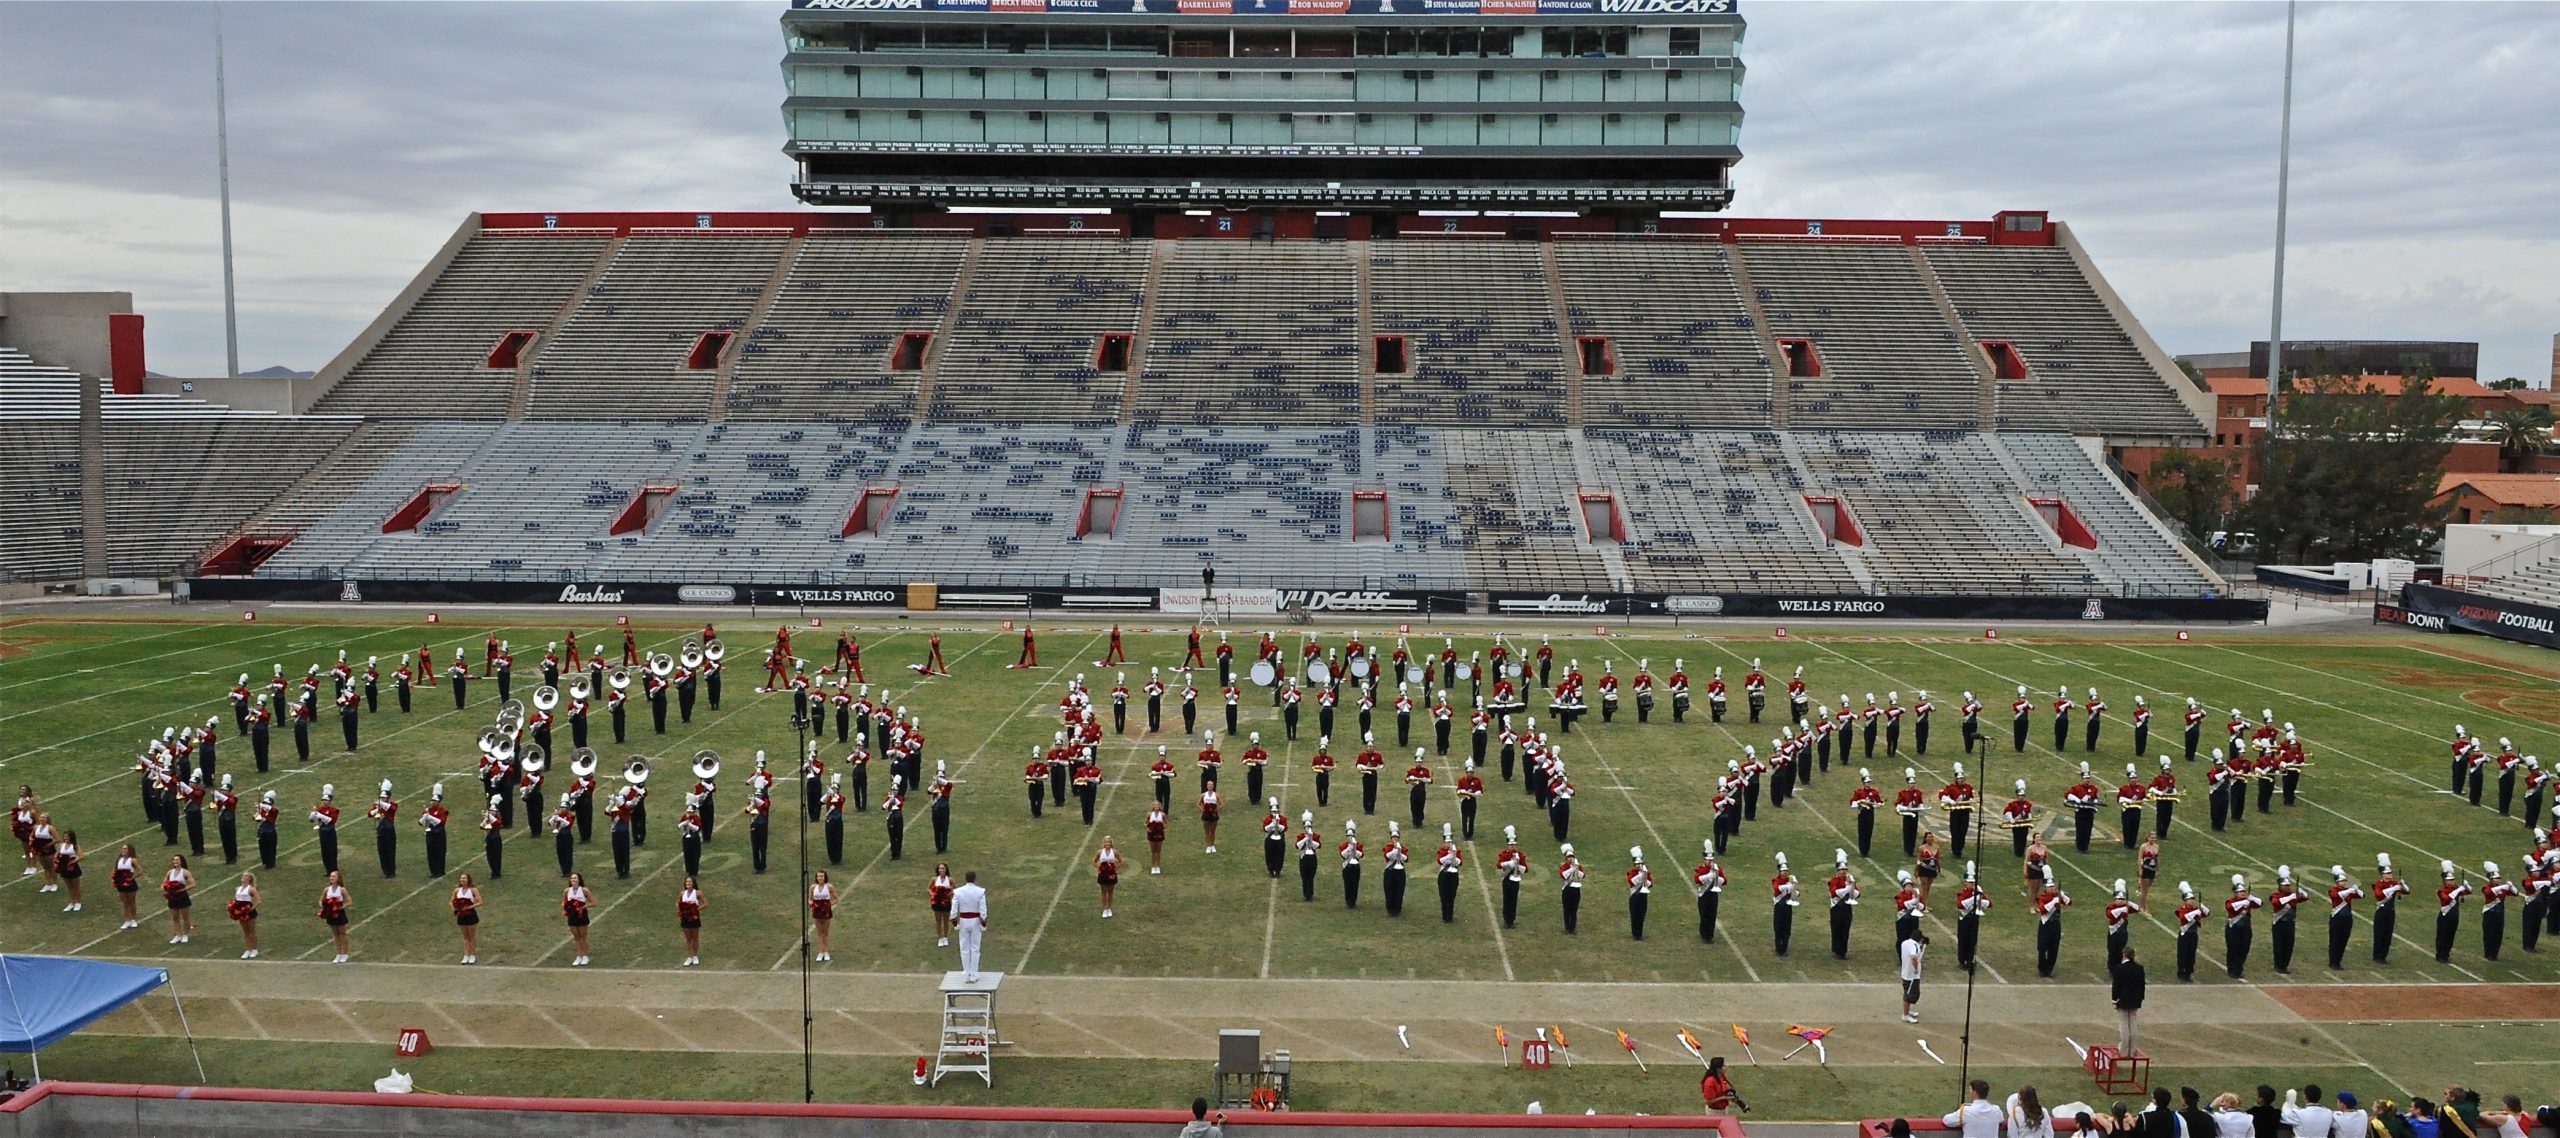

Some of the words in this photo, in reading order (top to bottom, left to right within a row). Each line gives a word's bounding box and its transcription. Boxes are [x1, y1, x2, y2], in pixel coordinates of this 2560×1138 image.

[805, 0, 922, 8] ARIZONA
[1601, 0, 1729, 12] WILDCATS
[546, 220, 556, 228] 17
[698, 220, 709, 228] 18
[873, 220, 883, 228] 19
[1069, 221, 1082, 229] 20
[1219, 221, 1230, 230] 21
[1445, 223, 1457, 231] 22
[1645, 224, 1657, 233] 23
[1808, 227, 1820, 235] 24
[1948, 228, 1960, 236] 25
[182, 383, 192, 391] 16
[559, 585, 624, 602] Bashas'
[790, 591, 841, 602] WELLS
[845, 591, 894, 602] FARGO
[1164, 593, 1197, 606] UNIVERSITY
[1240, 596, 1259, 606] BAND
[1260, 596, 1273, 606] DAY
[1778, 601, 1830, 612] WELLS
[1834, 601, 1885, 612] FARGO
[2498, 612, 2554, 633] FOOTBALL
[399, 1032, 418, 1052] 40
[1527, 1045, 1545, 1064] 40
